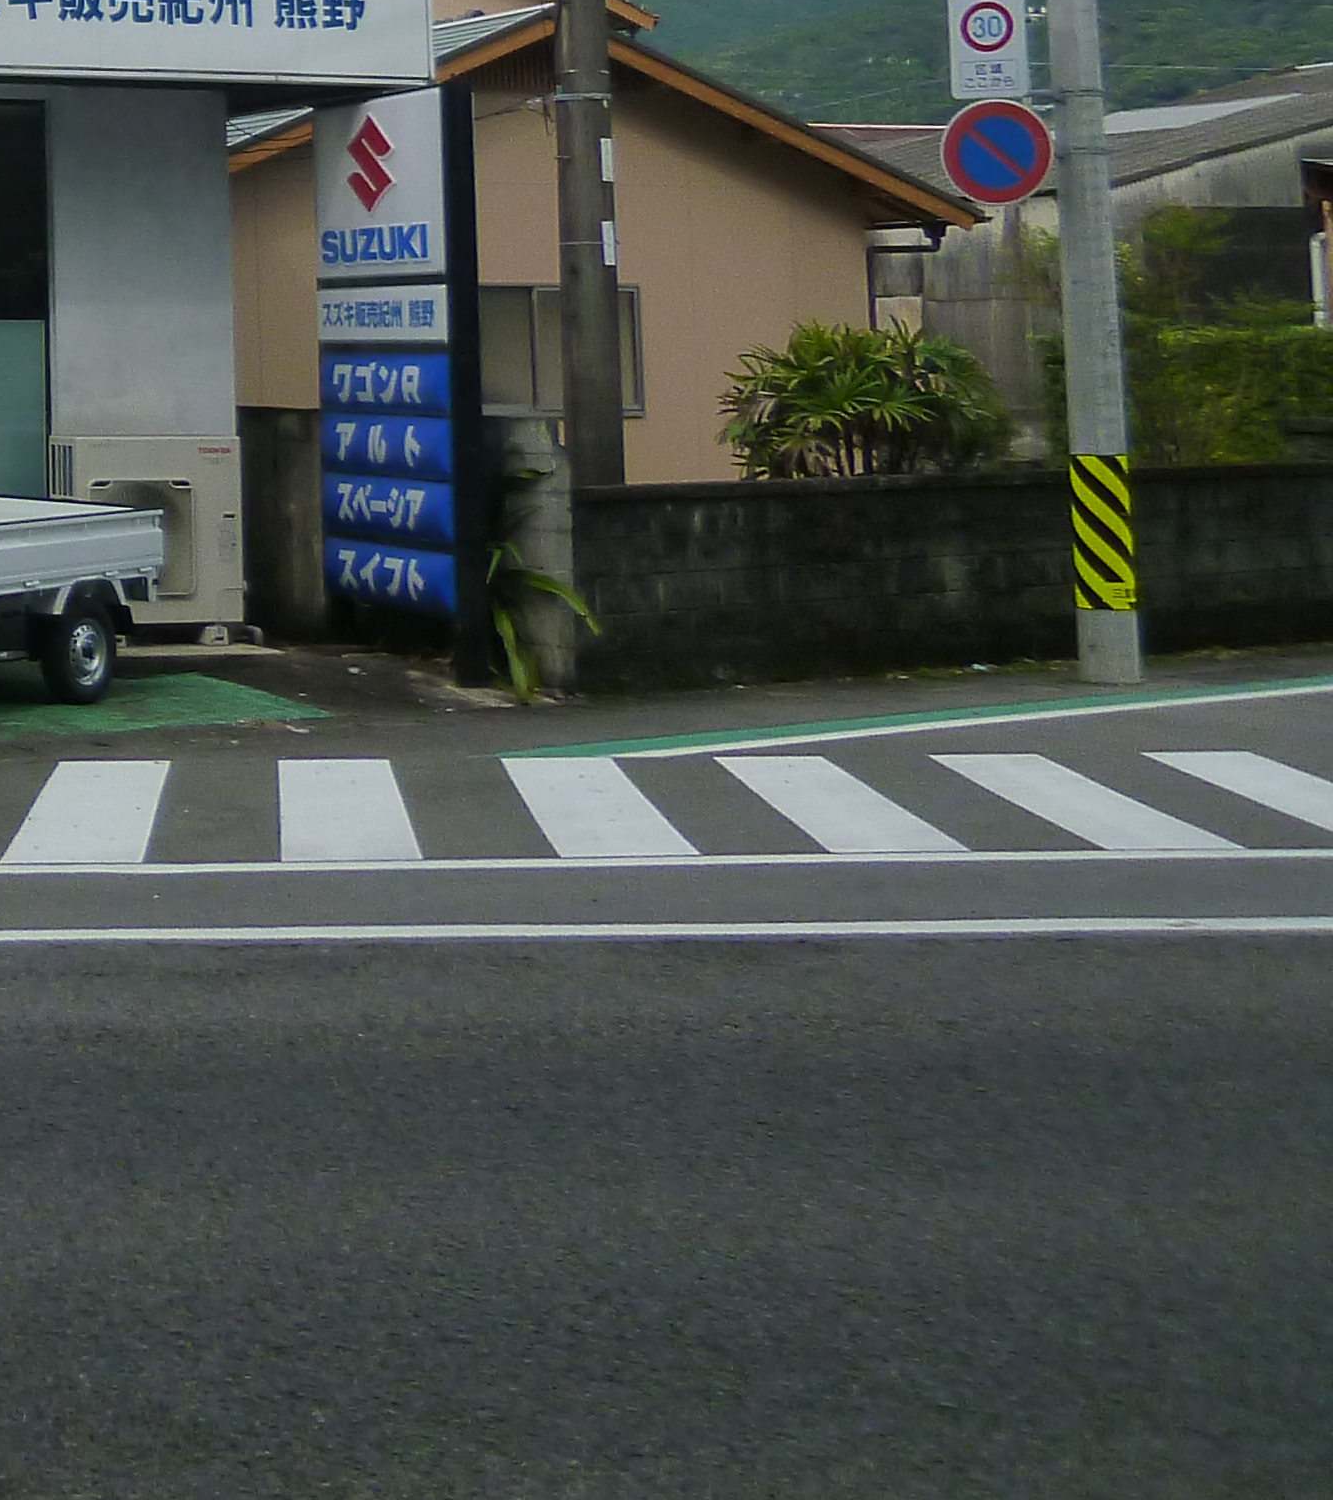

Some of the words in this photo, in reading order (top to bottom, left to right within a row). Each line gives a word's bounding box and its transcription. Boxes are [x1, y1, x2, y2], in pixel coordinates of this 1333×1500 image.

[972, 15, 1003, 39] 30
[964, 76, 1015, 89] ここから
[321, 223, 430, 265] SUZUKI
[333, 361, 422, 404] ワゴンR
[336, 422, 421, 467] アルト
[337, 483, 426, 530] スペーシア
[338, 549, 425, 600] スイフト
